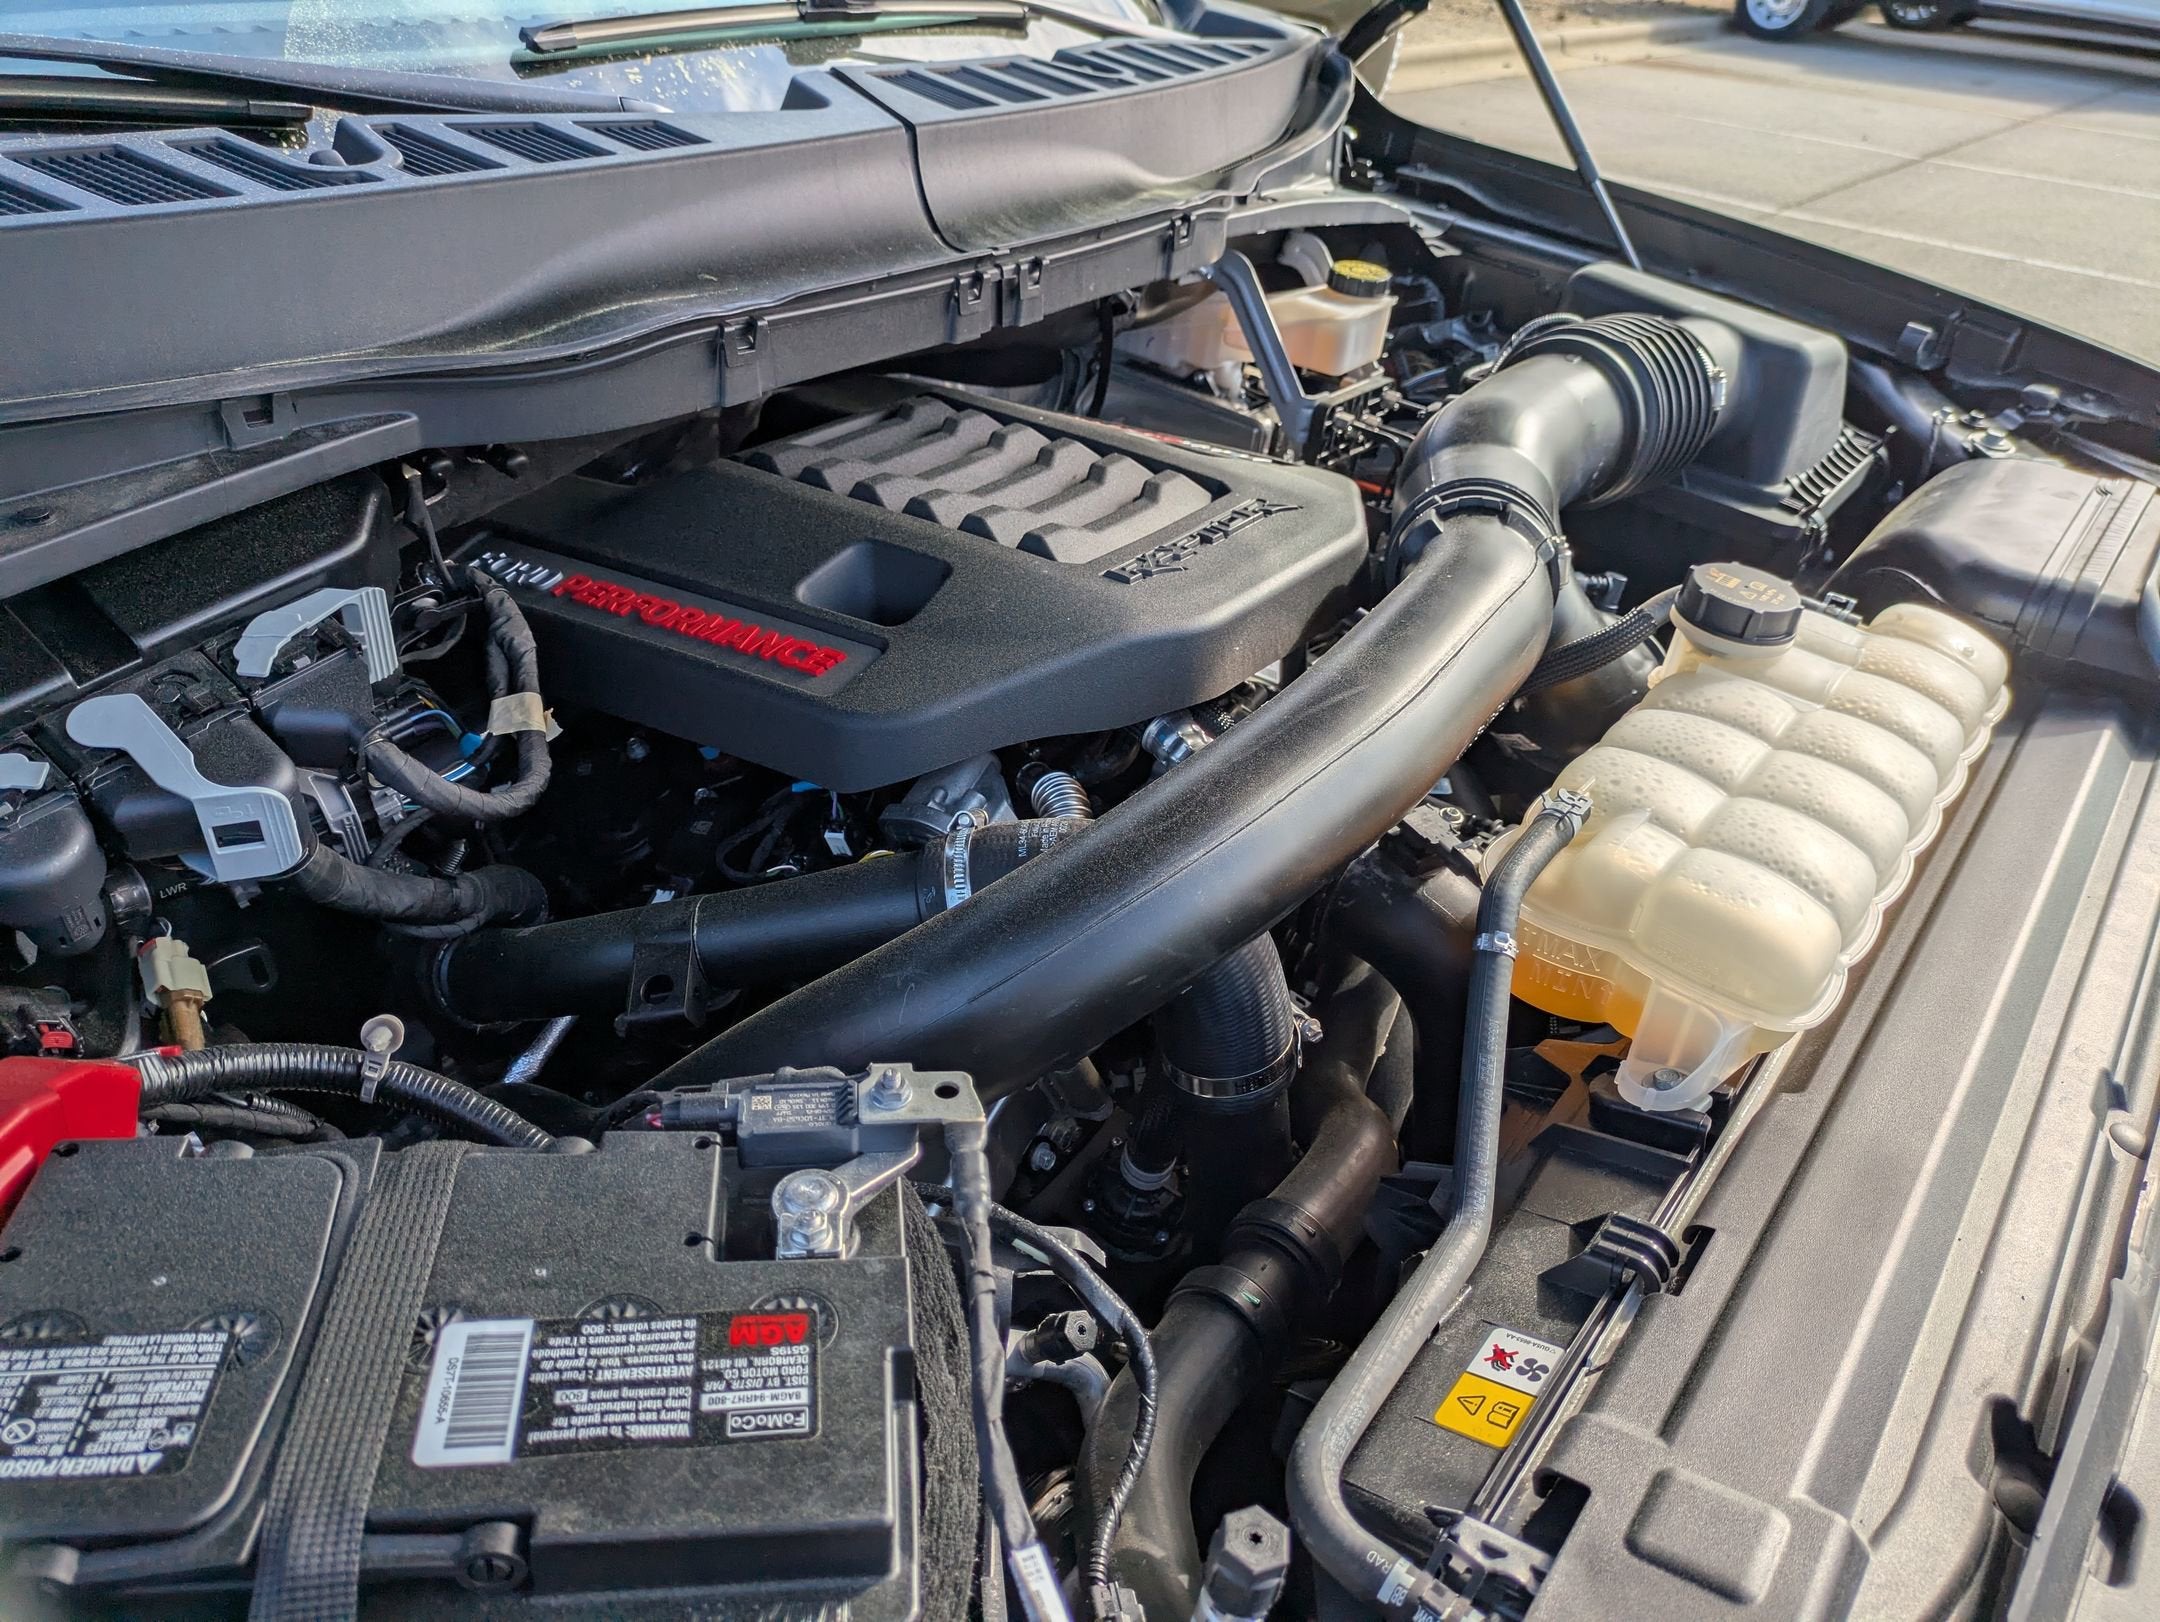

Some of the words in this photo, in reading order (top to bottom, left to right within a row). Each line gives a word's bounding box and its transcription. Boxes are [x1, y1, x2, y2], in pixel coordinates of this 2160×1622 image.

[467, 551, 563, 591] FORD
[550, 571, 848, 677] PERFORMANCE
[159, 882, 187, 899] LWR
[1536, 934, 1601, 972] MAX
[1529, 961, 1596, 999] MIN
[729, 1323, 808, 1346] AGM
[554, 1357, 585, 1370] guide
[599, 1356, 621, 1368] Voir
[677, 1354, 695, 1365] des
[734, 1358, 747, 1368] MI
[562, 1368, 586, 1381] Pour
[596, 1365, 693, 1379] AVERTISSEMENT
[721, 1368, 739, 1379] CO.
[740, 1367, 779, 1377] MOTOR
[781, 1365, 809, 1375] FORD
[704, 1380, 726, 1390] PAR
[729, 1378, 763, 1388] DISTR.
[767, 1377, 780, 1387] BY
[782, 1375, 809, 1386] DIST.
[560, 1391, 585, 1402] 800
[590, 1388, 620, 1400] amps
[622, 1387, 667, 1399] cranking
[669, 1386, 691, 1397] Cold
[638, 1399, 663, 1411] start
[665, 1396, 691, 1409] jump
[570, 1412, 602, 1425] guide
[603, 1412, 636, 1423] owner
[637, 1411, 659, 1421] see
[660, 1409, 690, 1421] injury
[730, 1411, 806, 1431] FoMoCo
[553, 1416, 568, 1427] for
[528, 1429, 576, 1442] personal
[578, 1426, 608, 1438] avoid
[609, 1425, 622, 1437] To
[625, 1423, 690, 1438] WARNING:
[1366, 1550, 1392, 1574] RAD
